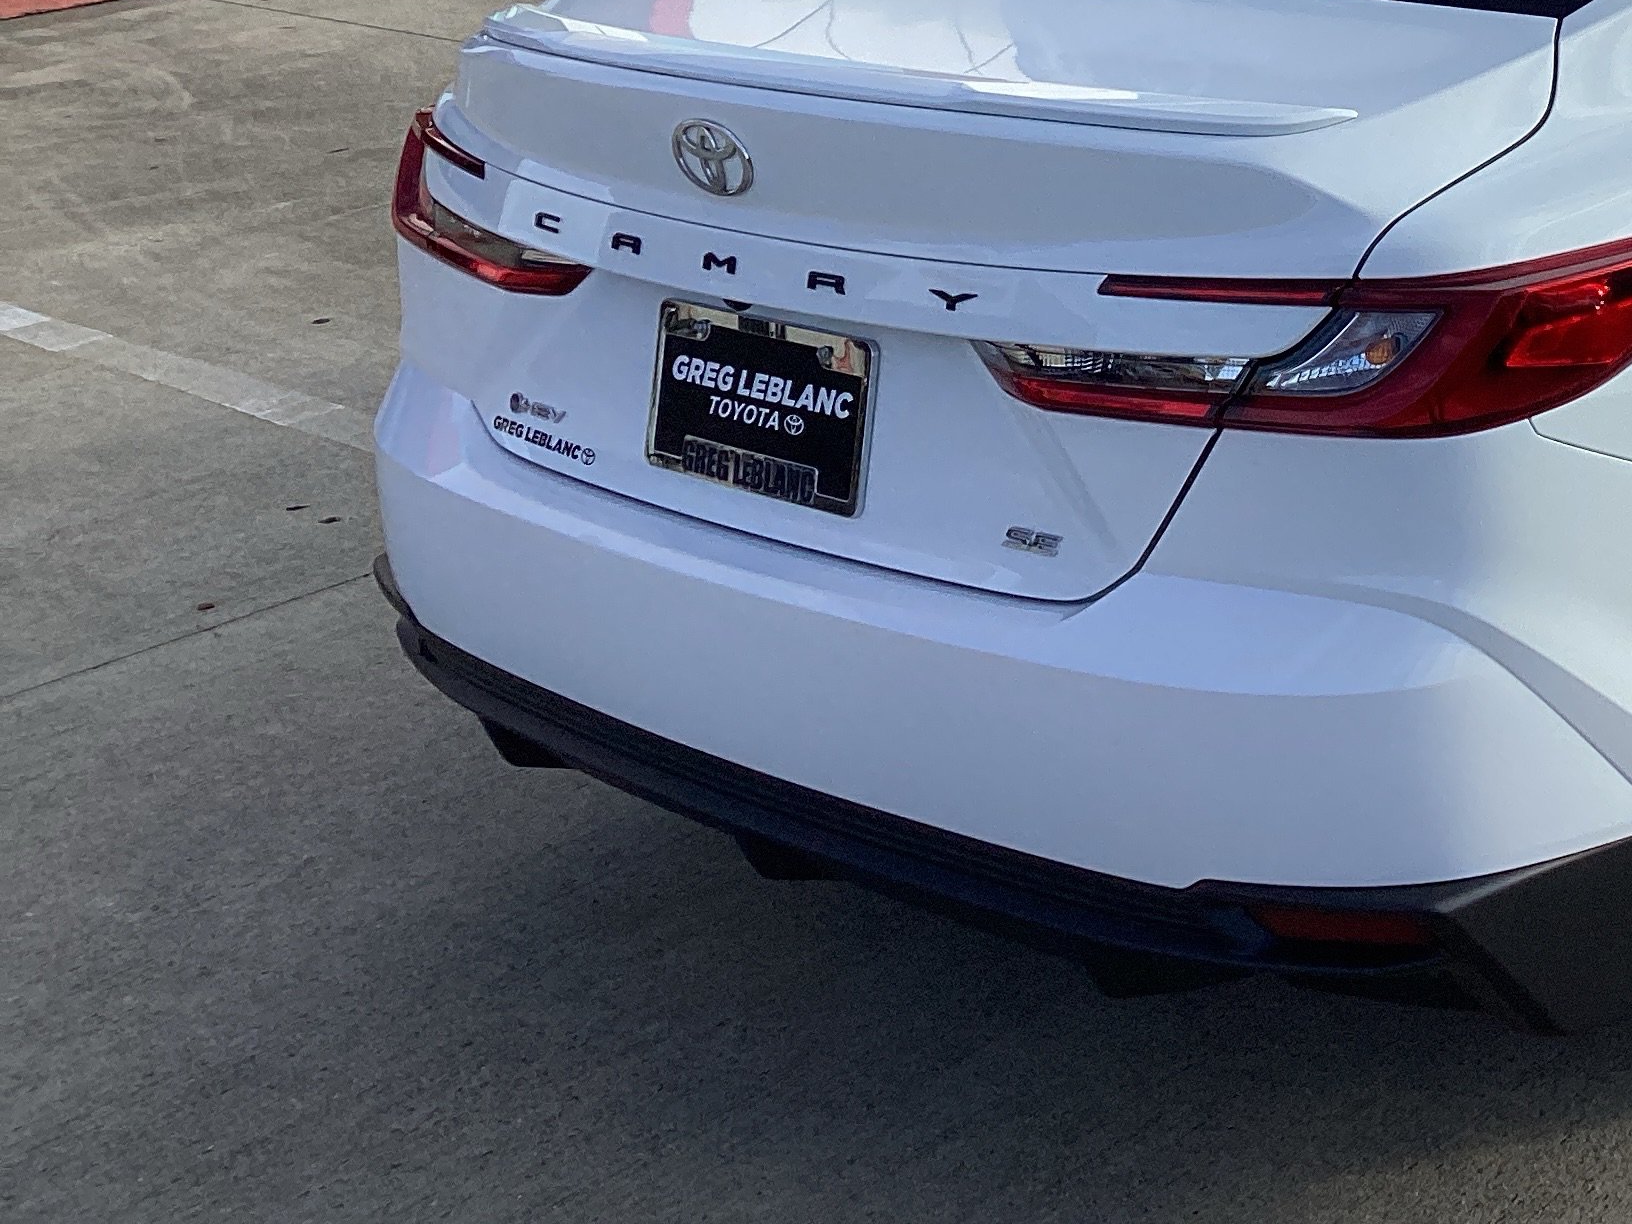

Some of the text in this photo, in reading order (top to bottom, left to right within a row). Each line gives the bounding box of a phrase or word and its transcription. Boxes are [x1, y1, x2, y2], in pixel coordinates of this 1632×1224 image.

[534, 211, 979, 311] CAMRY
[672, 354, 854, 419] GREG LEBLANC
[709, 395, 780, 431] TOYOTA
[493, 415, 581, 460] GREG LEBLANC
[682, 440, 731, 482] GREG
